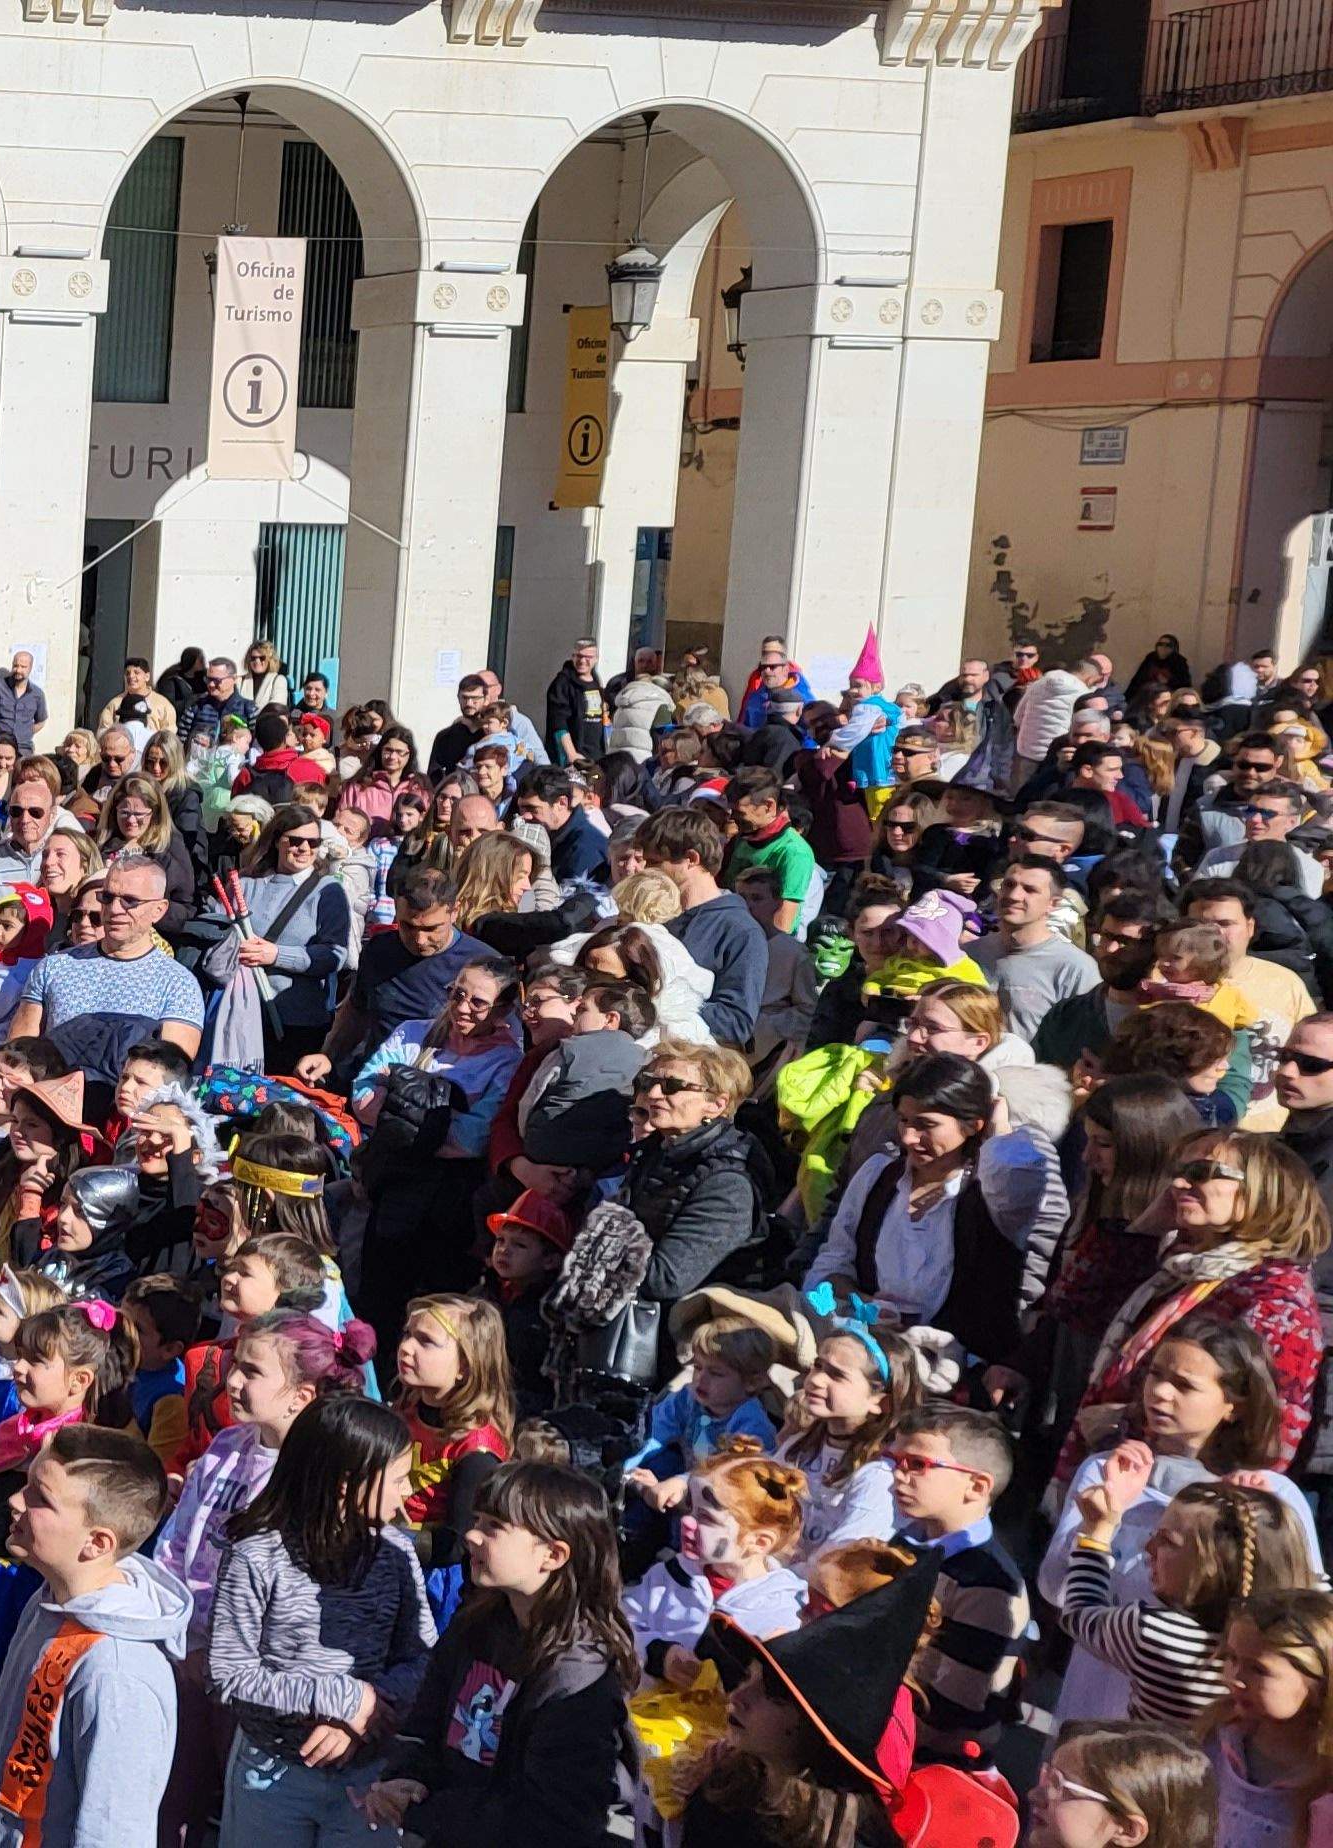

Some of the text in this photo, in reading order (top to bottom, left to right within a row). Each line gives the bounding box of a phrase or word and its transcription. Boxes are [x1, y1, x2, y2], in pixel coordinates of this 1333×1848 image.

[236, 261, 295, 279] Oficina
[273, 283, 295, 300] de
[224, 305, 293, 322] Turismo
[576, 337, 607, 349] Oficina
[596, 352, 607, 364] de
[571, 368, 606, 379] Turismo
[8, 1676, 42, 1783] SMILEY
